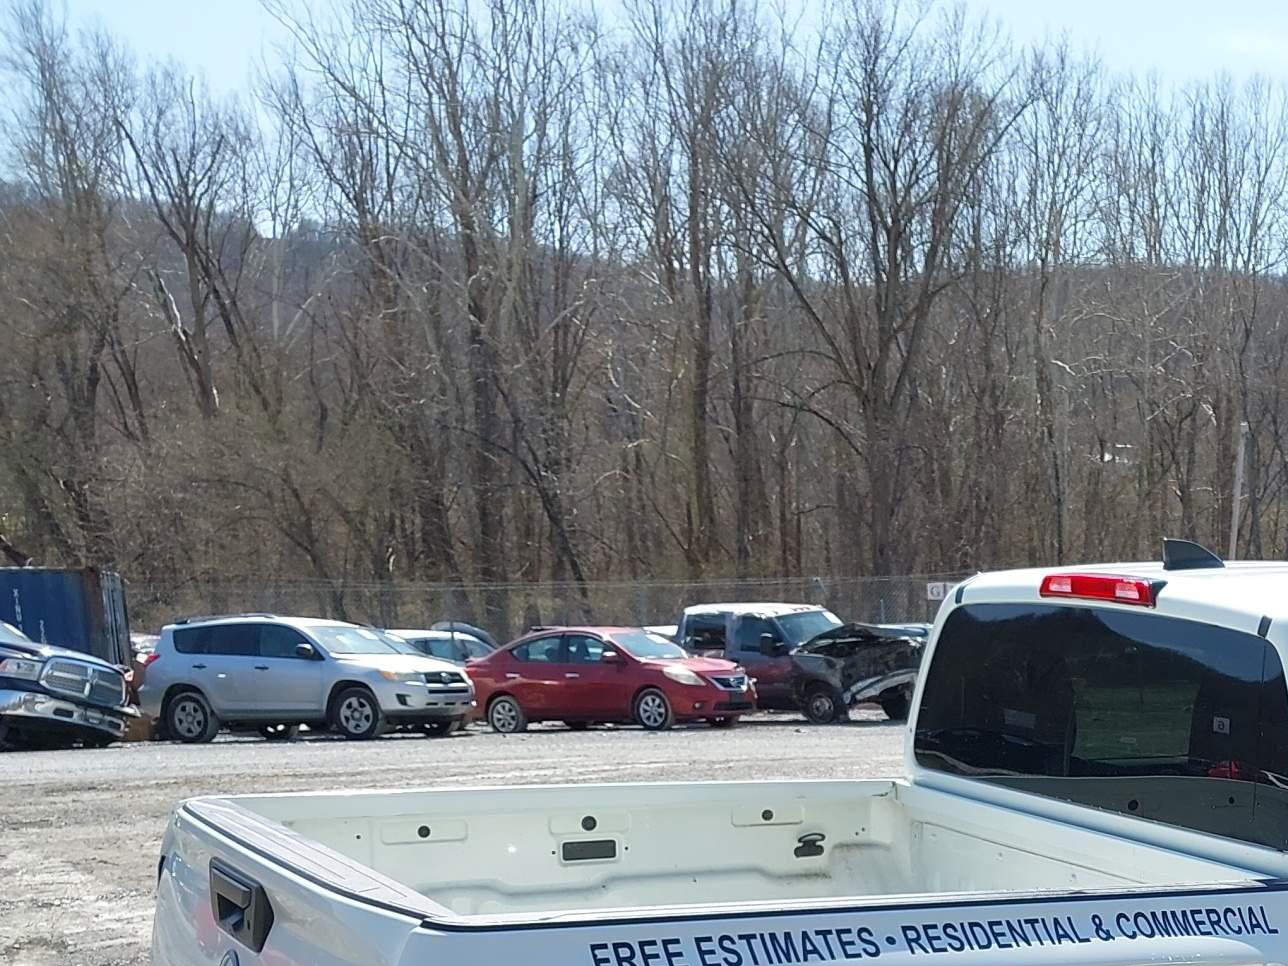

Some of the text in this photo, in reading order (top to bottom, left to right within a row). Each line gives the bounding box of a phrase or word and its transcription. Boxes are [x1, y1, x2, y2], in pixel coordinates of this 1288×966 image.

[901, 916, 1091, 955] RESIDENTIAL
[1094, 914, 1115, 943] &
[1116, 906, 1279, 940] COMMERCIAL
